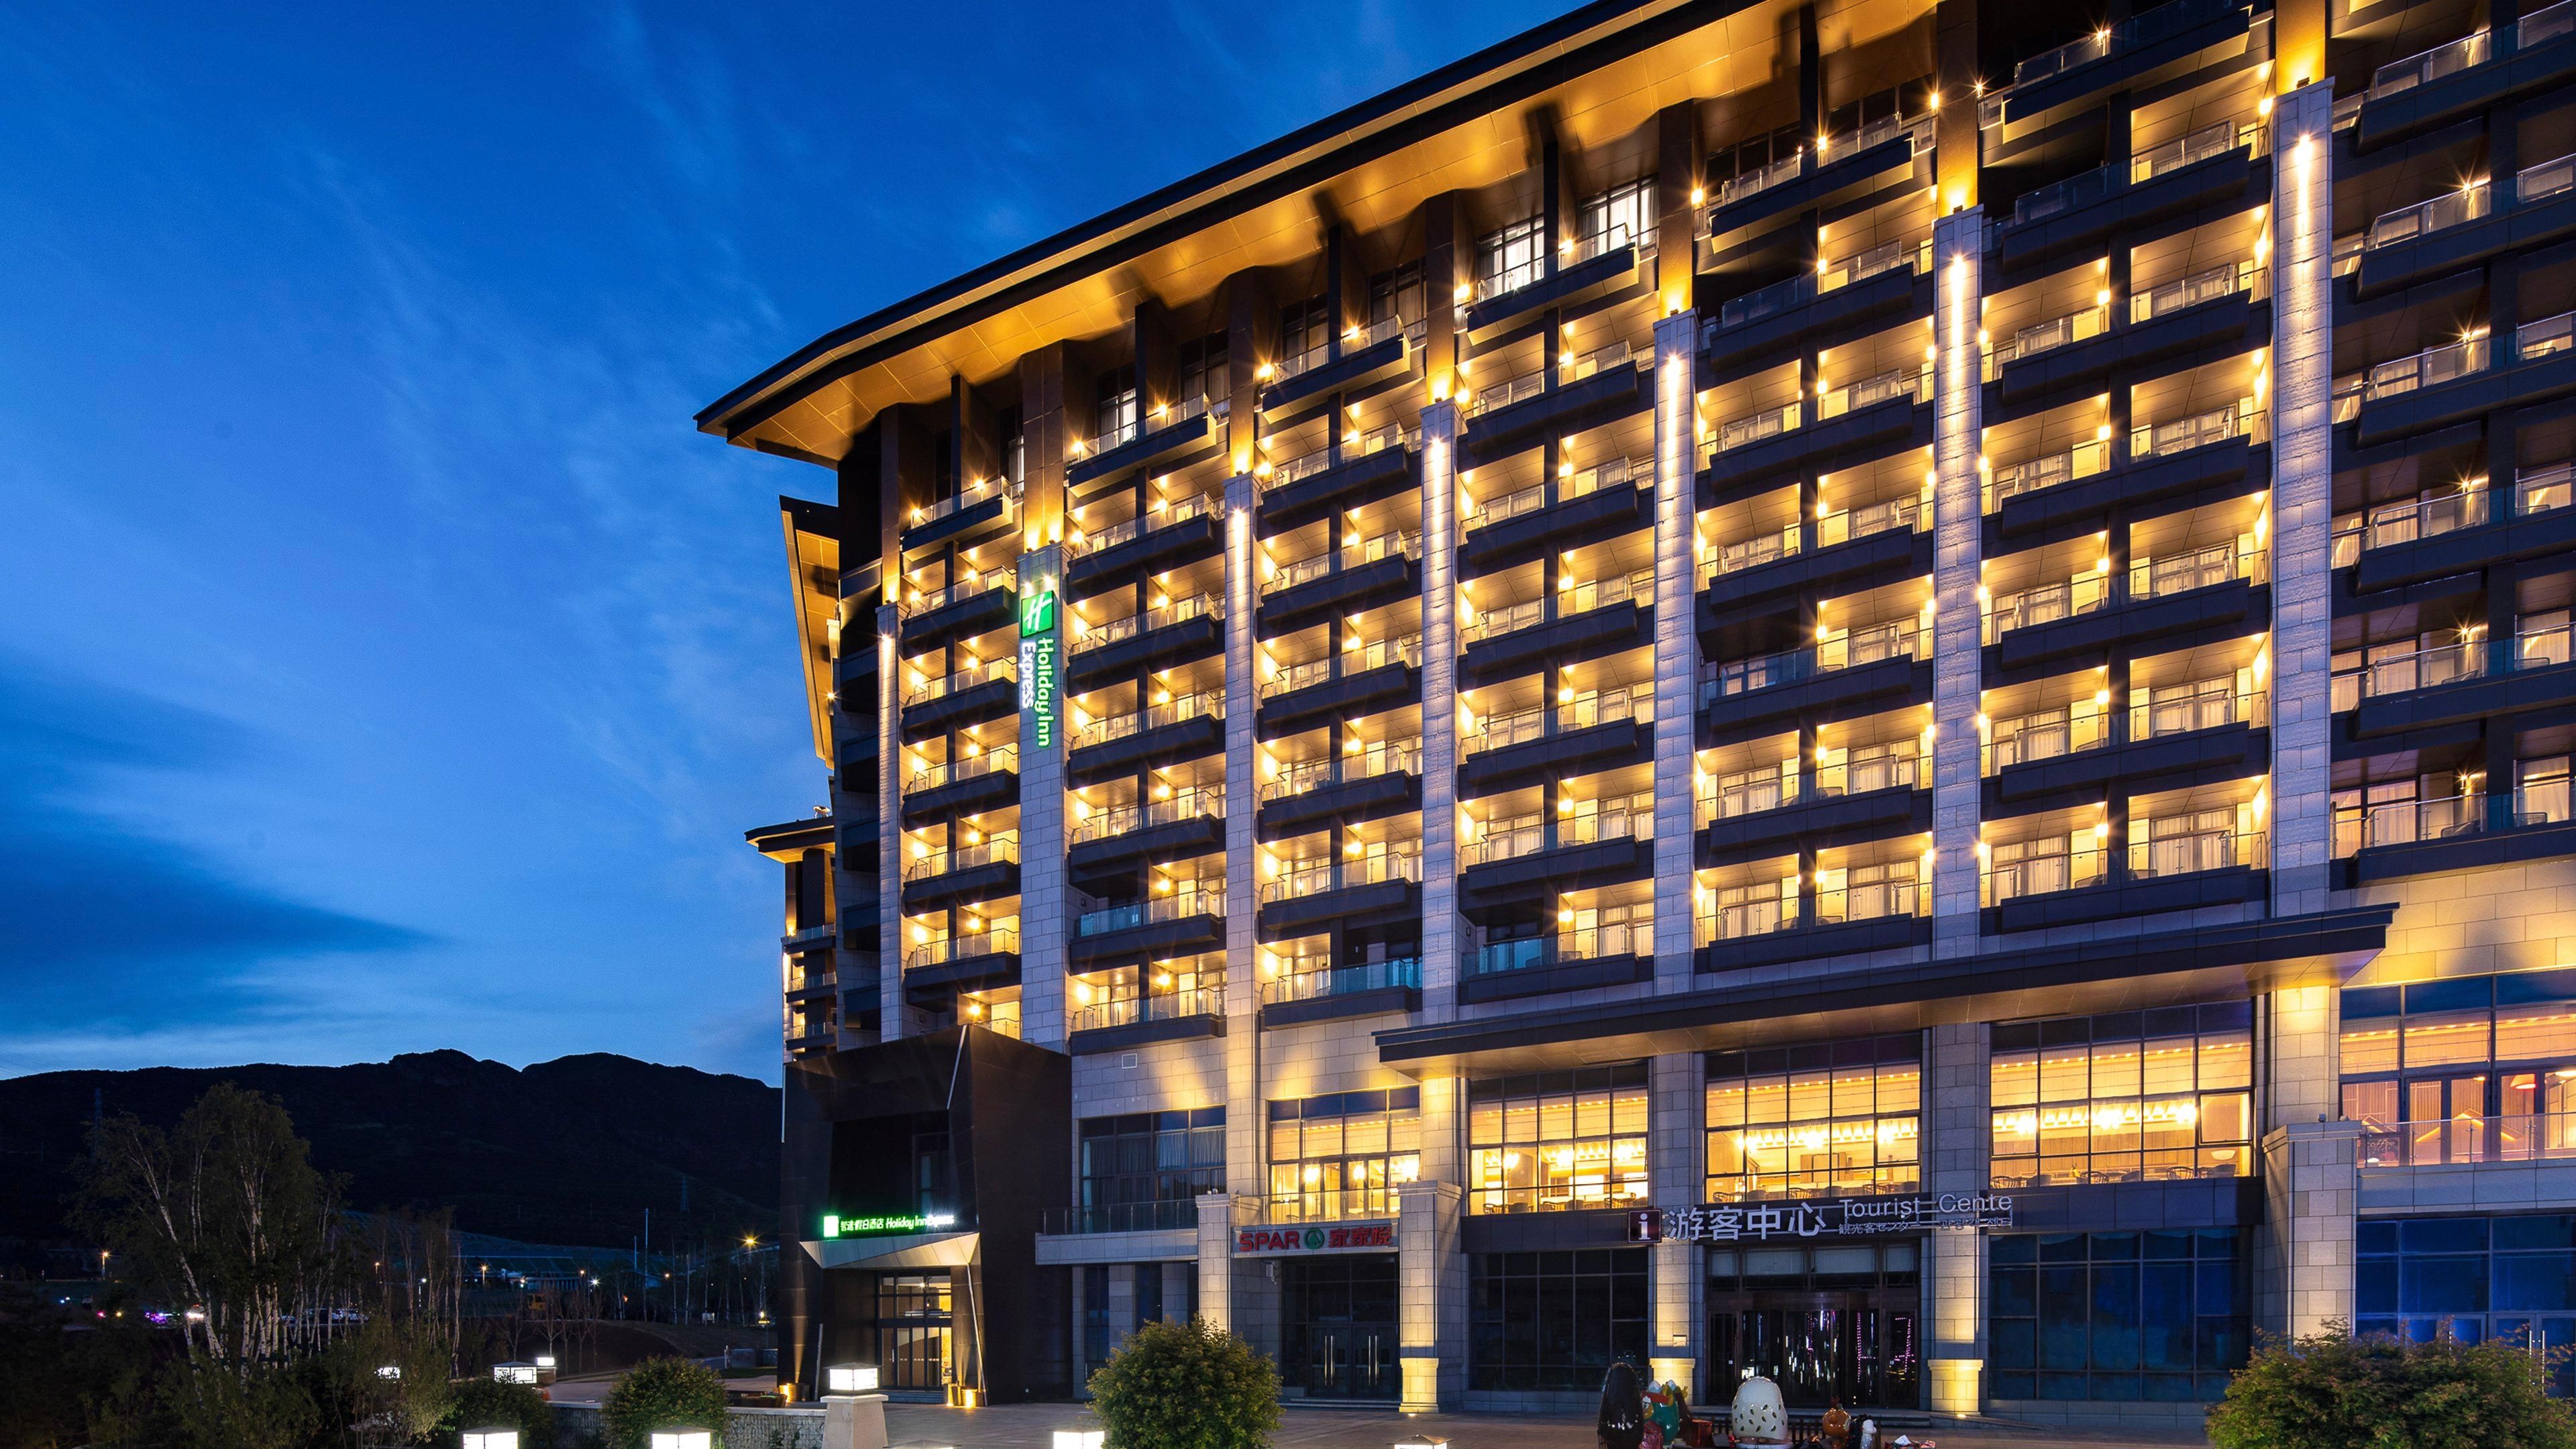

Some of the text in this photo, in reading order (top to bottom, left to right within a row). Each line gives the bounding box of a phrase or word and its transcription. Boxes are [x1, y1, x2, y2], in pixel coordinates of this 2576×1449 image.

[1020, 642, 1035, 708] Express
[1035, 637, 1055, 747] Holiday Inn
[1839, 1193, 2012, 1217] Tourist Cente
[885, 1216, 914, 1230] Holiday
[915, 1215, 926, 1226] Inn
[1668, 1201, 1827, 1241] 游客中心
[1239, 1230, 1300, 1252] SPAR
[1329, 1226, 1393, 1248] 家家悦
